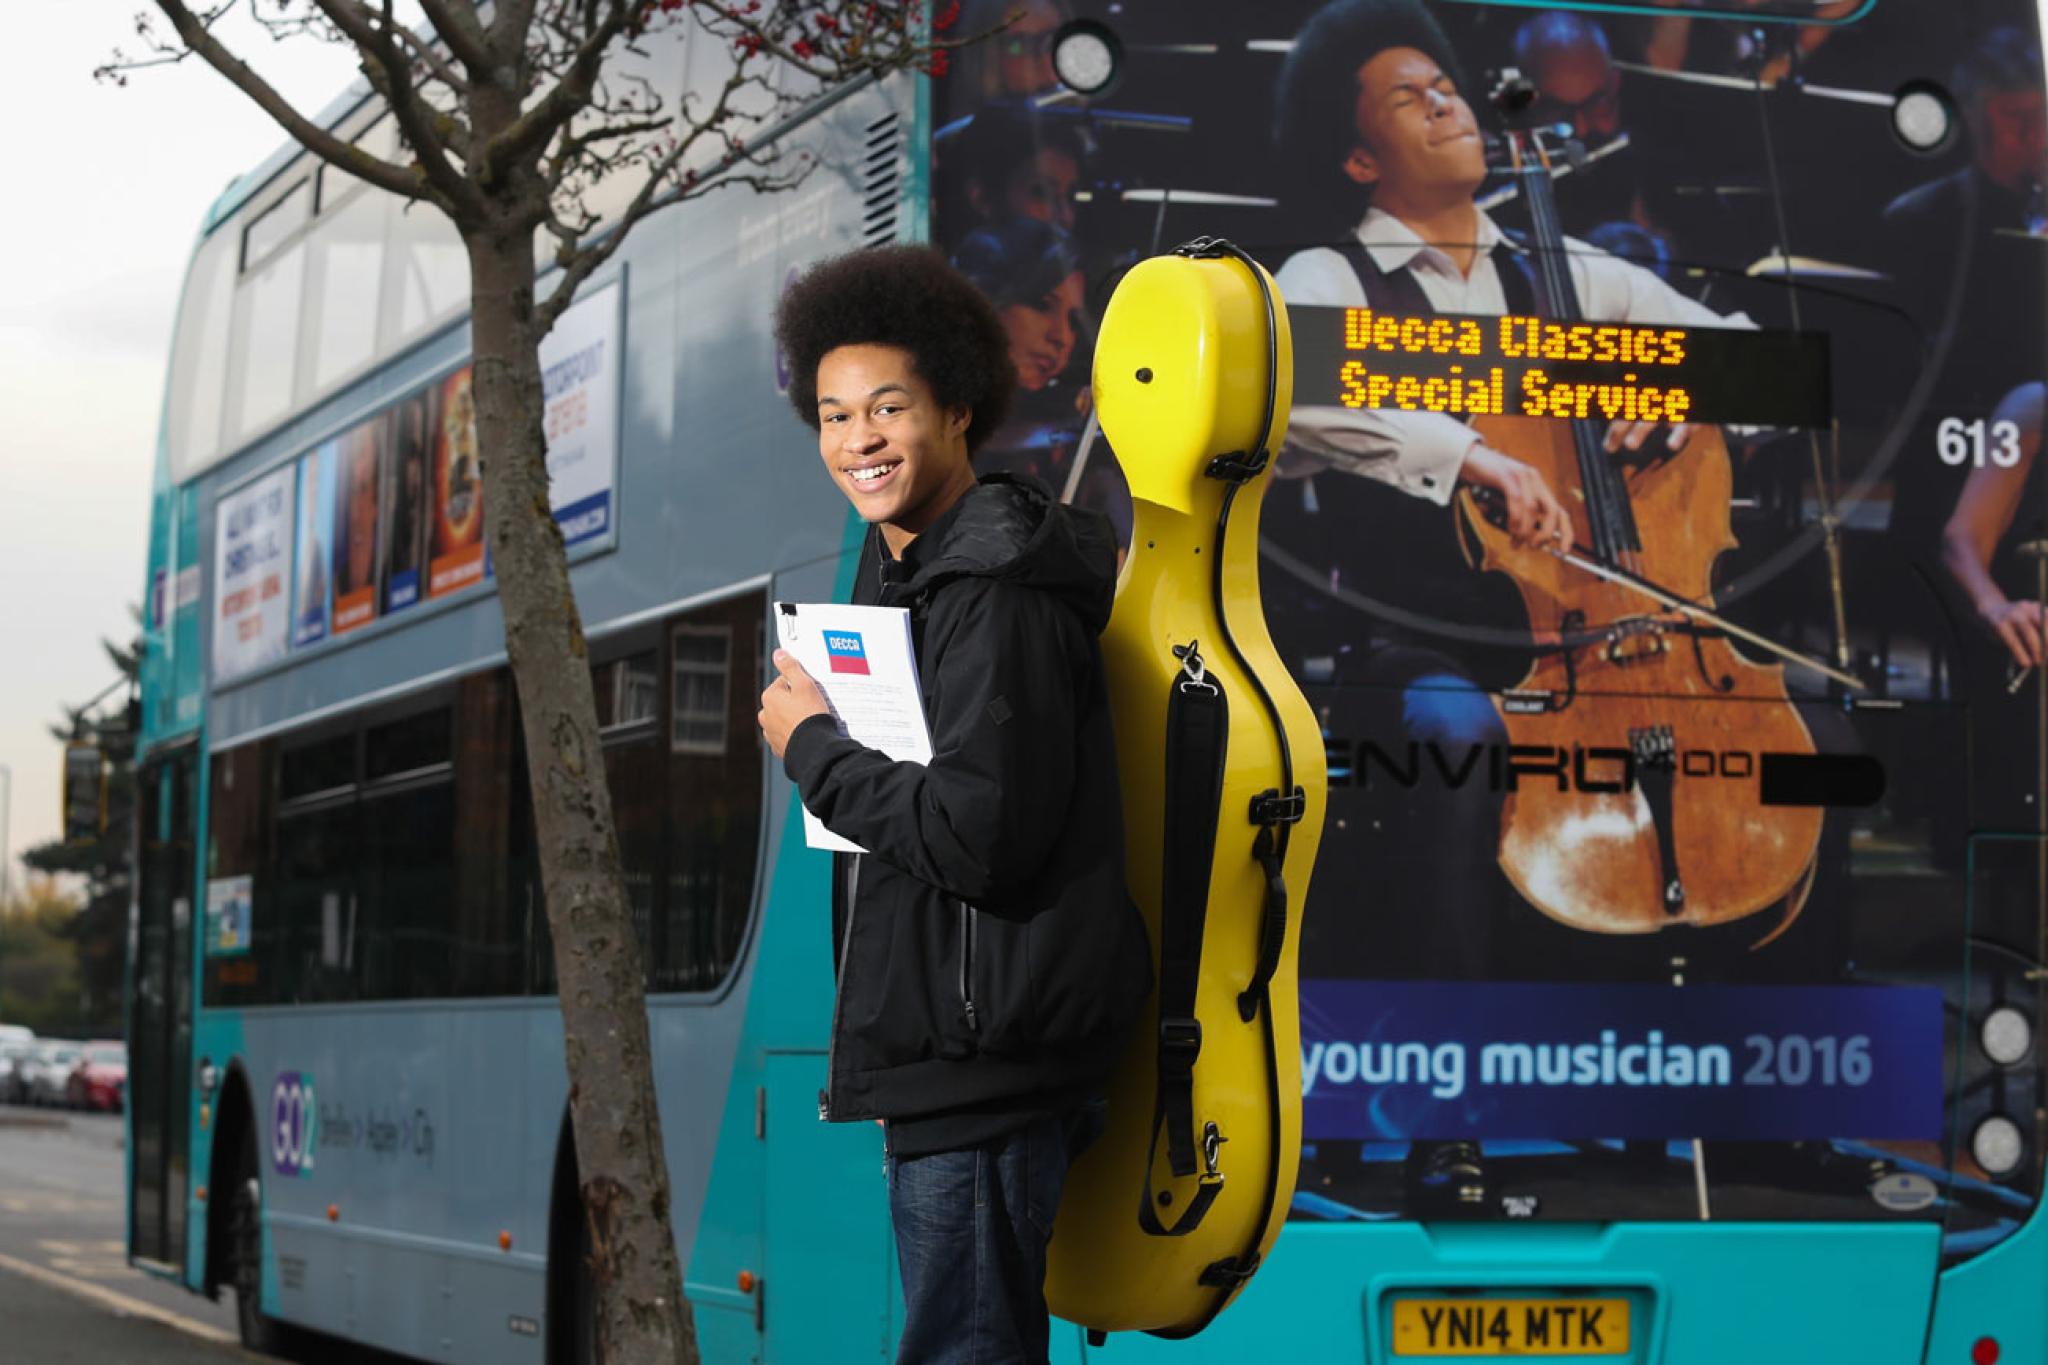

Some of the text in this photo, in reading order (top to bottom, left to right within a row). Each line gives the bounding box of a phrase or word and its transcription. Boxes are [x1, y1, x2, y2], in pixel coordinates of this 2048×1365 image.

[1499, 315, 1687, 364] Classics
[1340, 360, 1690, 423] Special Service
[1937, 417, 2021, 468] 613
[829, 636, 861, 651] DECCA
[1301, 1030, 1872, 1099] young musician 2016
[1420, 1306, 1604, 1348] YN14 MTK
